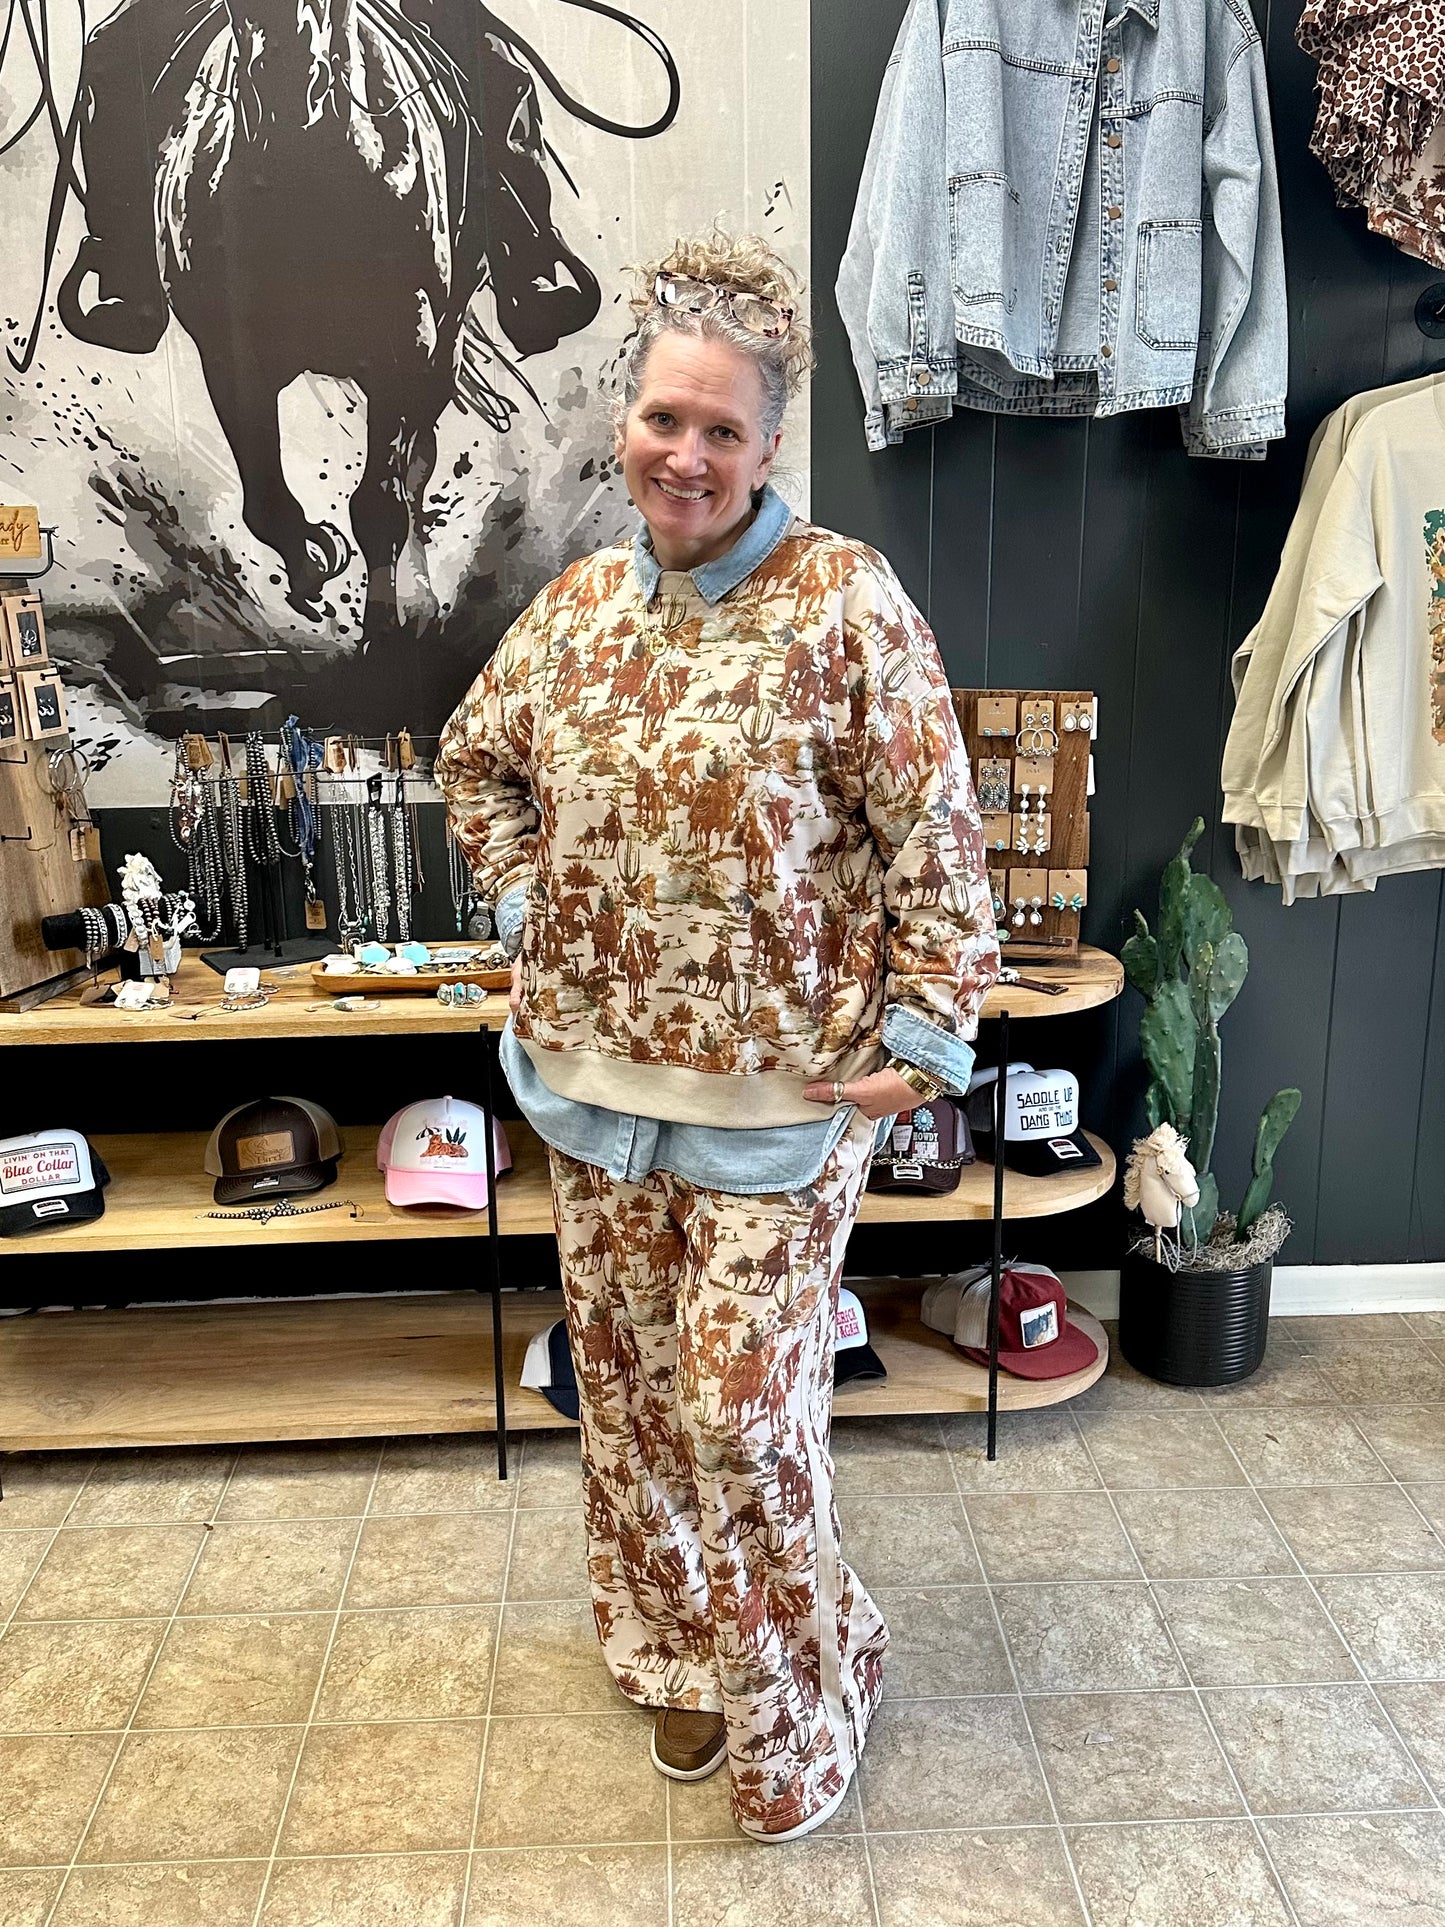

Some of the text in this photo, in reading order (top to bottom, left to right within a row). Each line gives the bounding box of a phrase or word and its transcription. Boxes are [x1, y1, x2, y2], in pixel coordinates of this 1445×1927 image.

[1016, 1086, 1073, 1109] SADDLE UP
[1020, 1113, 1050, 1131] DANG
[913, 1132, 939, 1142] HOWDY
[4, 1154, 30, 1164] LIVIN'
[49, 1149, 70, 1157] THAT
[3, 1158, 74, 1179] Blue Collar
[21, 1173, 60, 1185] DOLLAR
